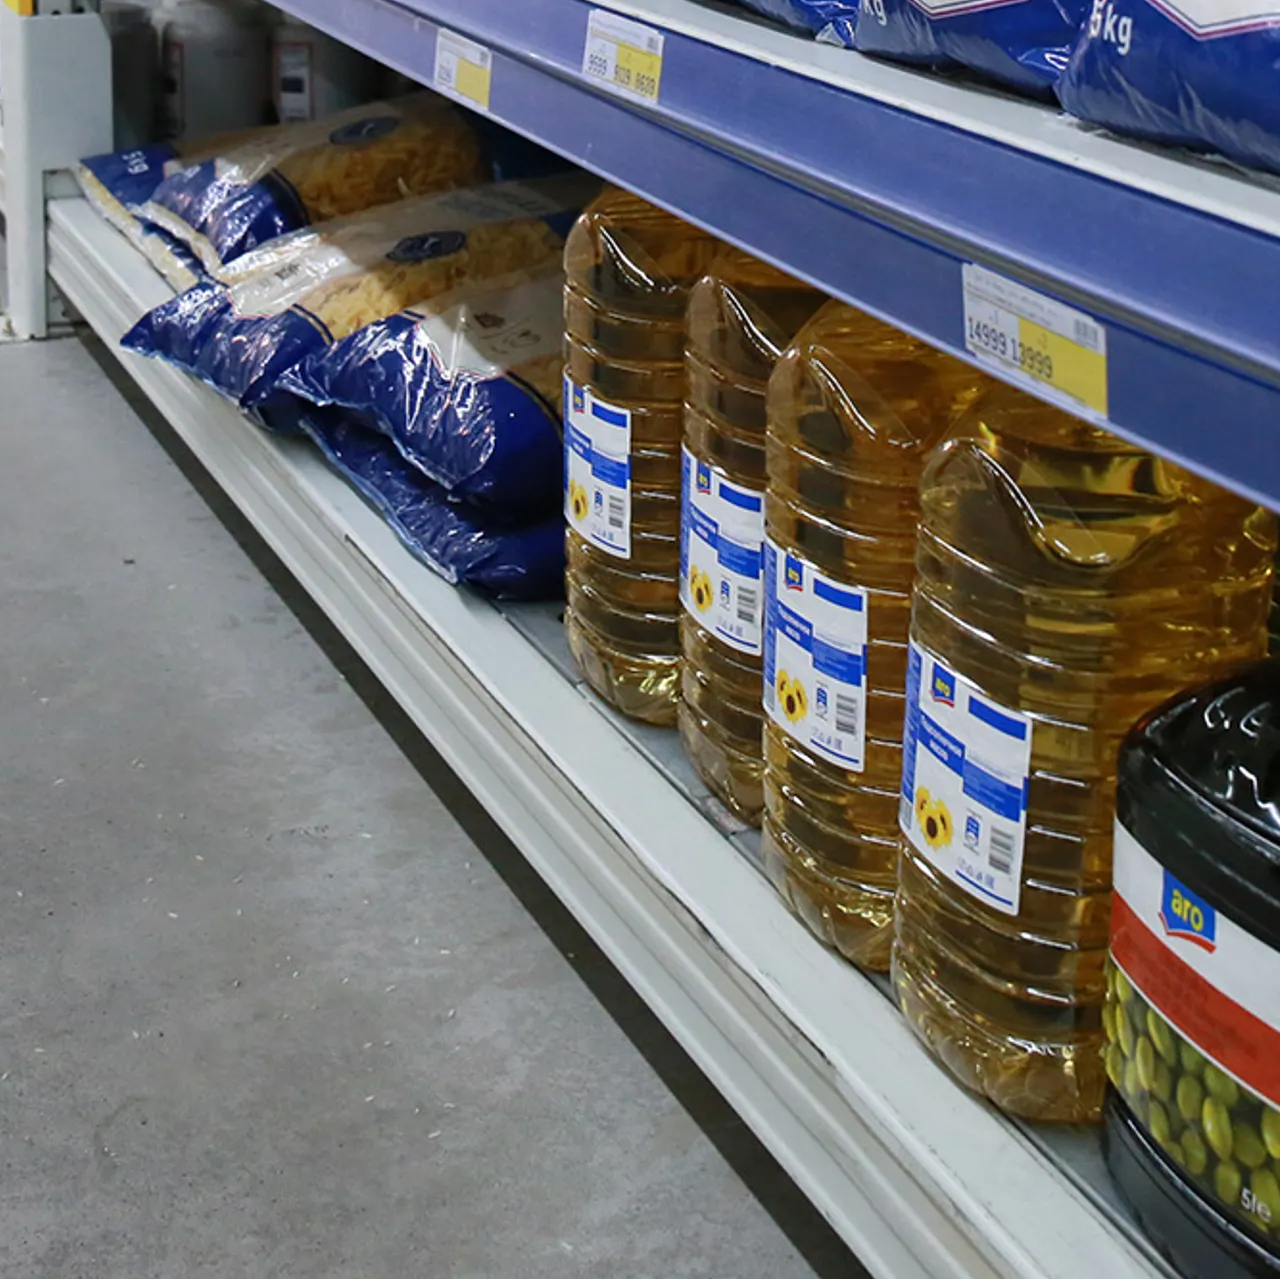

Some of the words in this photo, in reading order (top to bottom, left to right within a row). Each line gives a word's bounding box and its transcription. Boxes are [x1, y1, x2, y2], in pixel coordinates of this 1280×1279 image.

[968, 317, 1007, 356] 14999
[1010, 337, 1054, 380] 13999
[1170, 888, 1205, 932] aro
